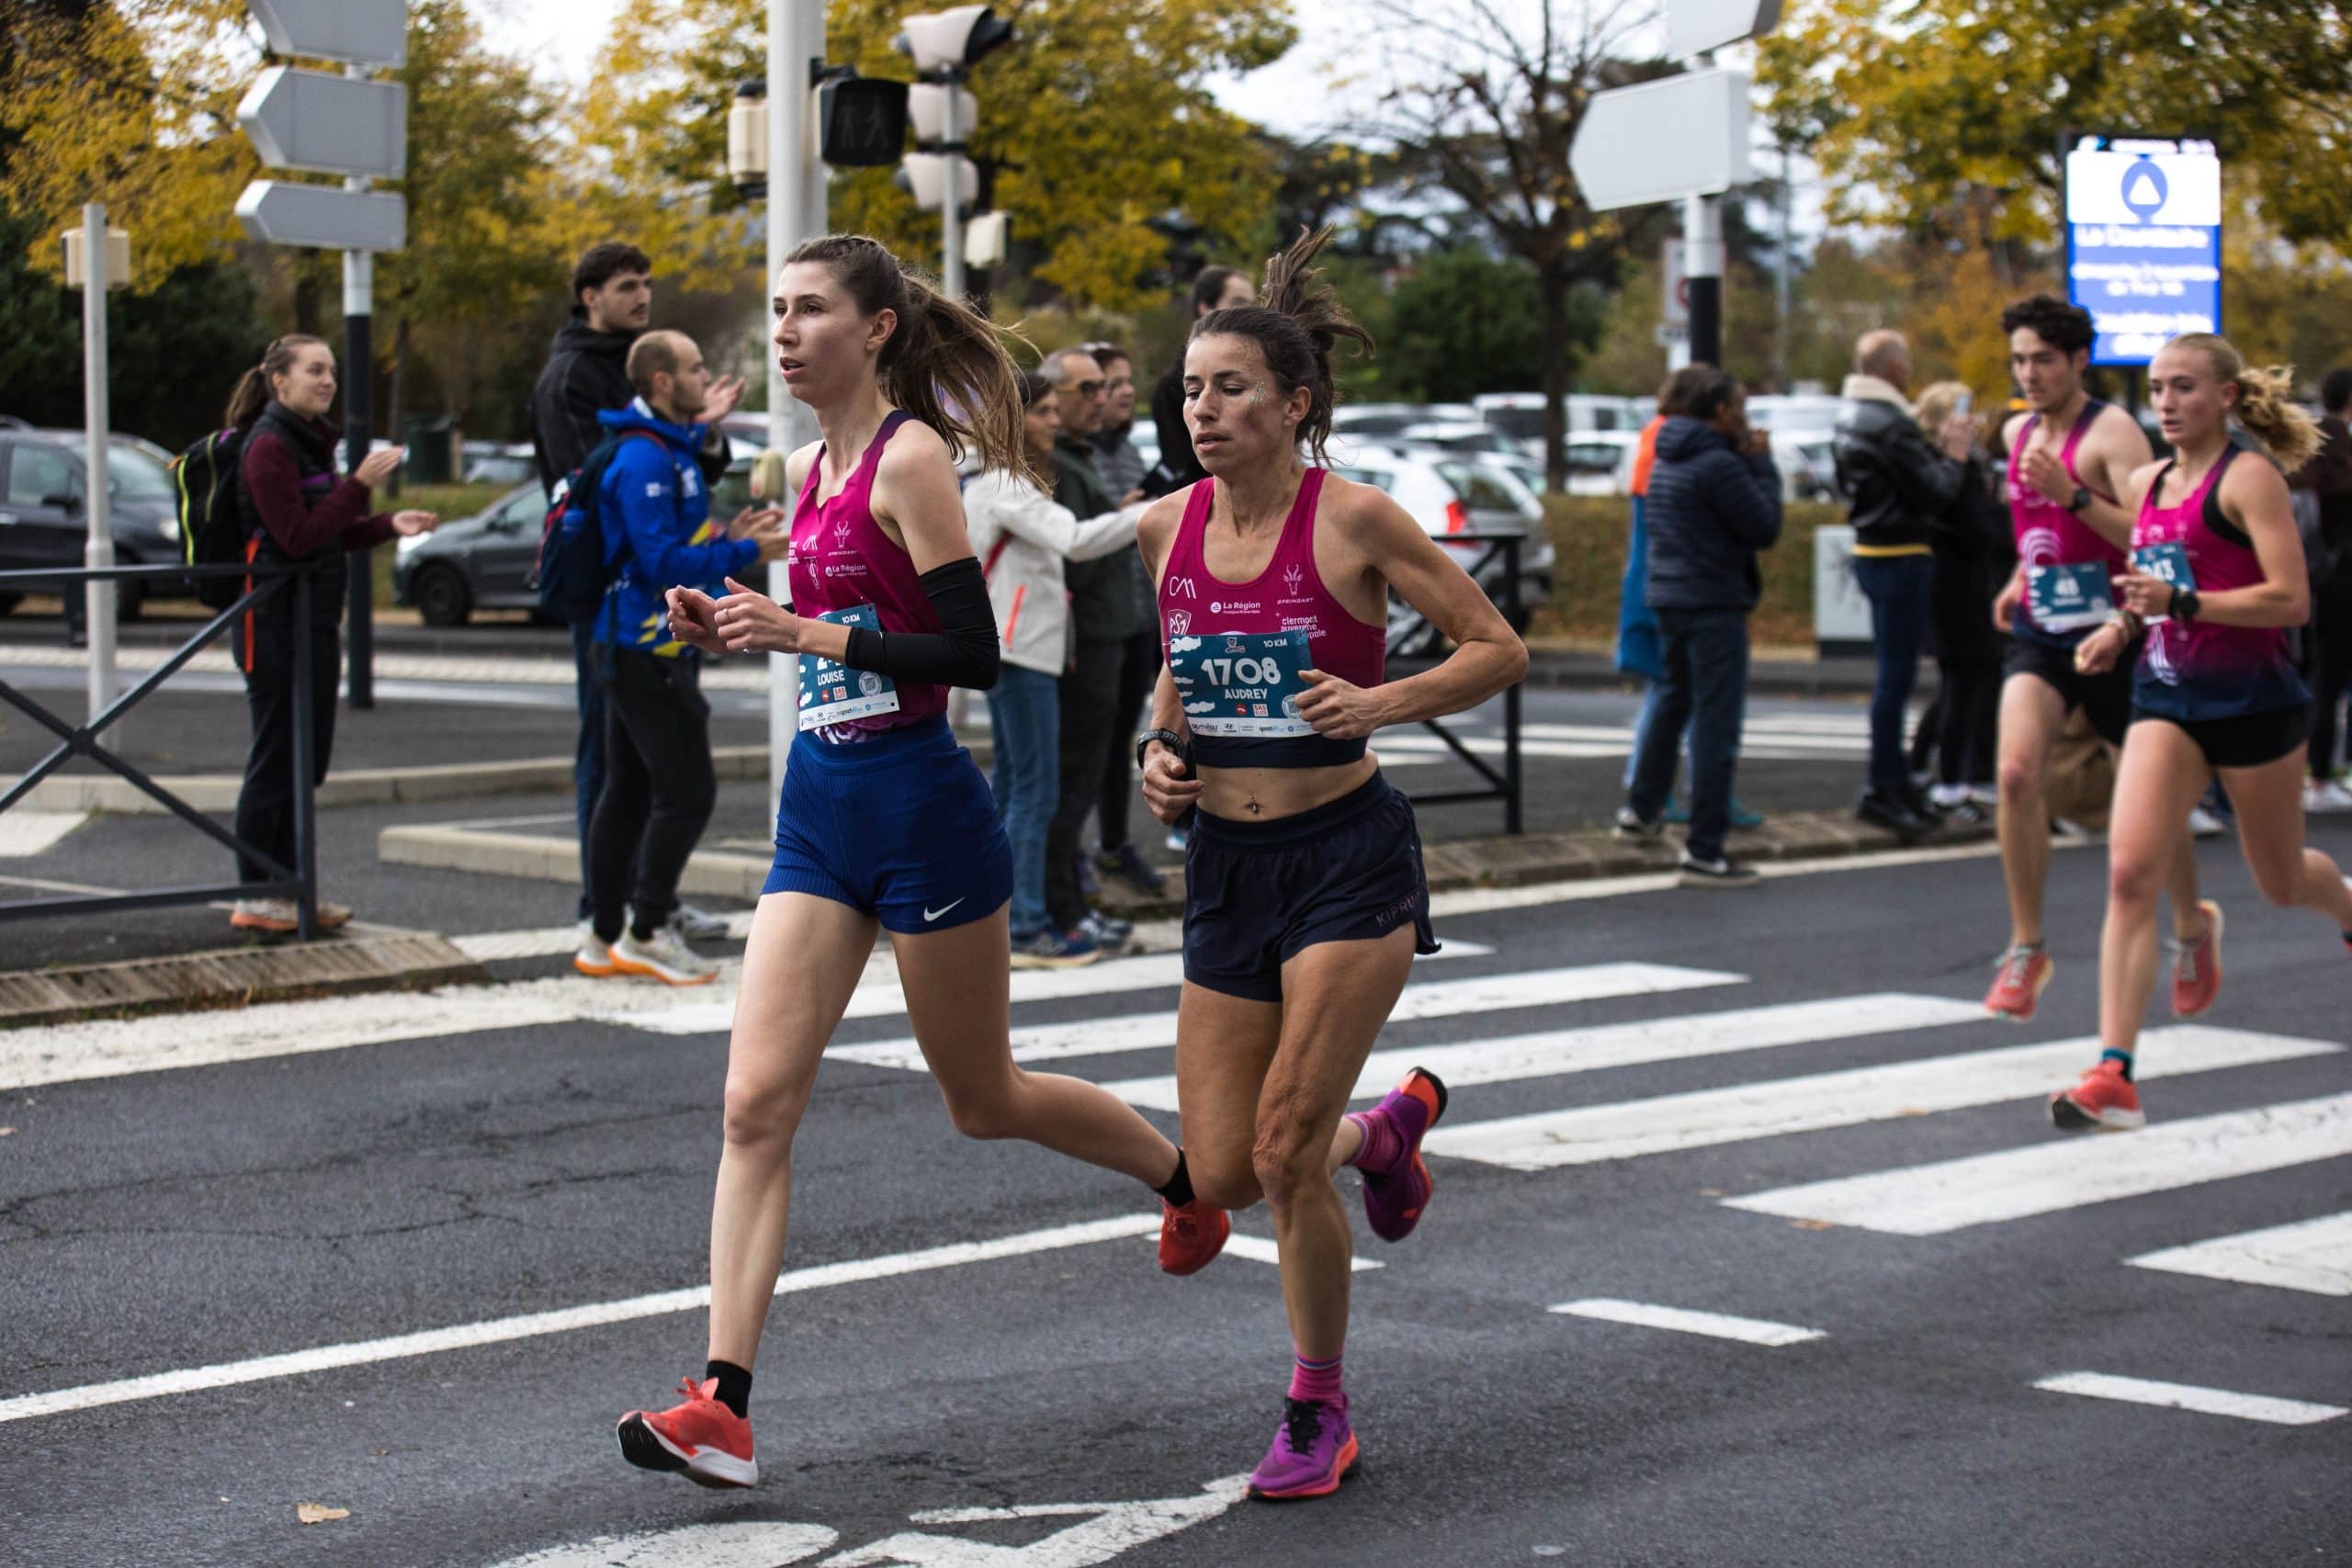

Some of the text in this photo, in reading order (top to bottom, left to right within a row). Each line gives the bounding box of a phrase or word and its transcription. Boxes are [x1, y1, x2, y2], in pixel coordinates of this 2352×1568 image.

[1234, 601, 1261, 610] Région
[842, 614, 860, 624] 10 KM
[1282, 615, 1317, 626] clermont
[1263, 638, 1288, 648] 10 KM
[1200, 657, 1281, 685] 1708
[817, 669, 845, 686] LOUISE
[1225, 688, 1268, 699] AUDREY
